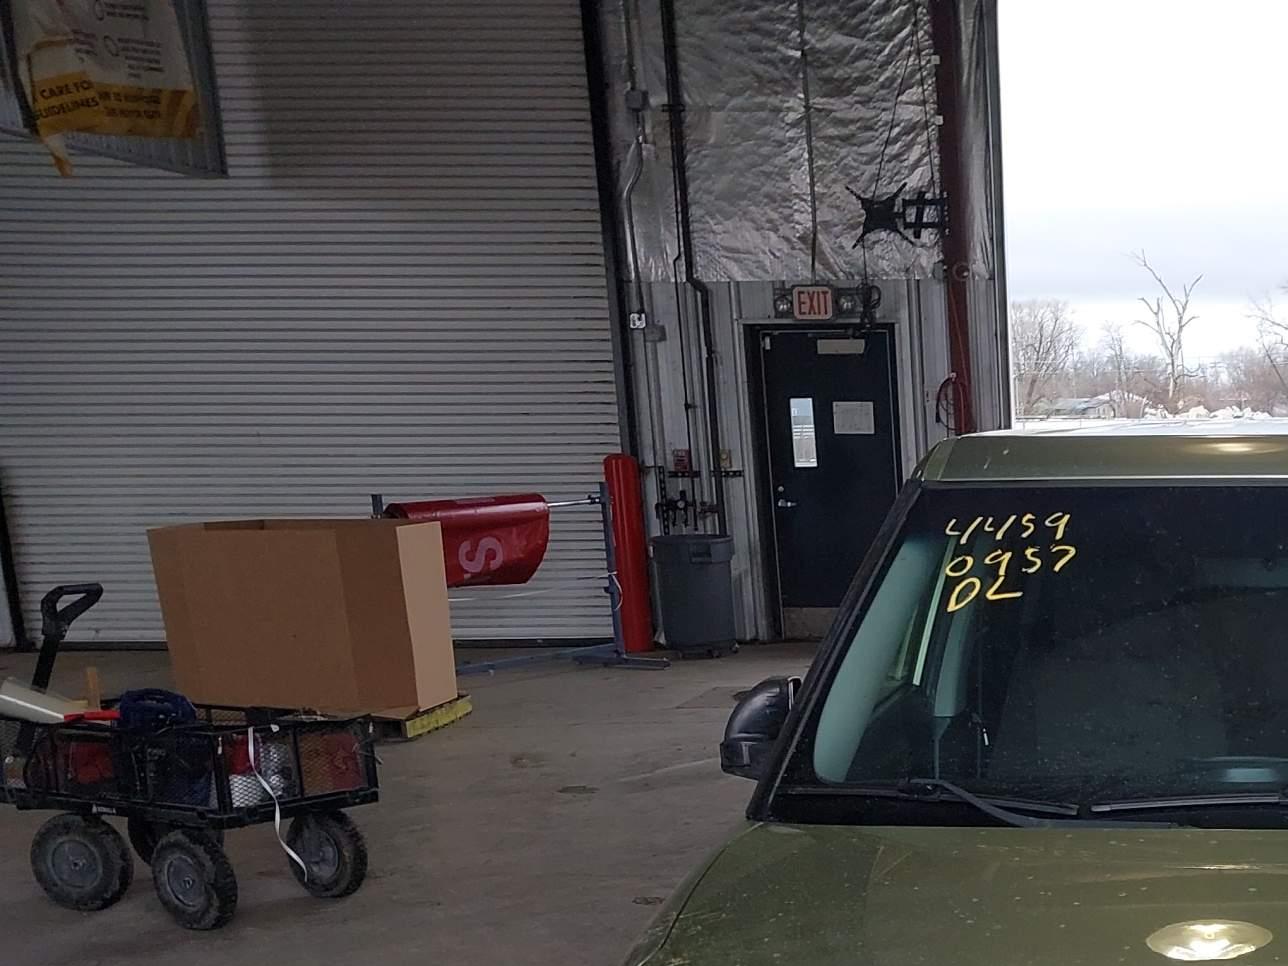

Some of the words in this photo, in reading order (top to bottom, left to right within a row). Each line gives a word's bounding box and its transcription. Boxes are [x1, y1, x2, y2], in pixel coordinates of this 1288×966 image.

[797, 290, 829, 316] EXIT
[945, 512, 1071, 545] 4459
[945, 545, 1076, 577] 0957
